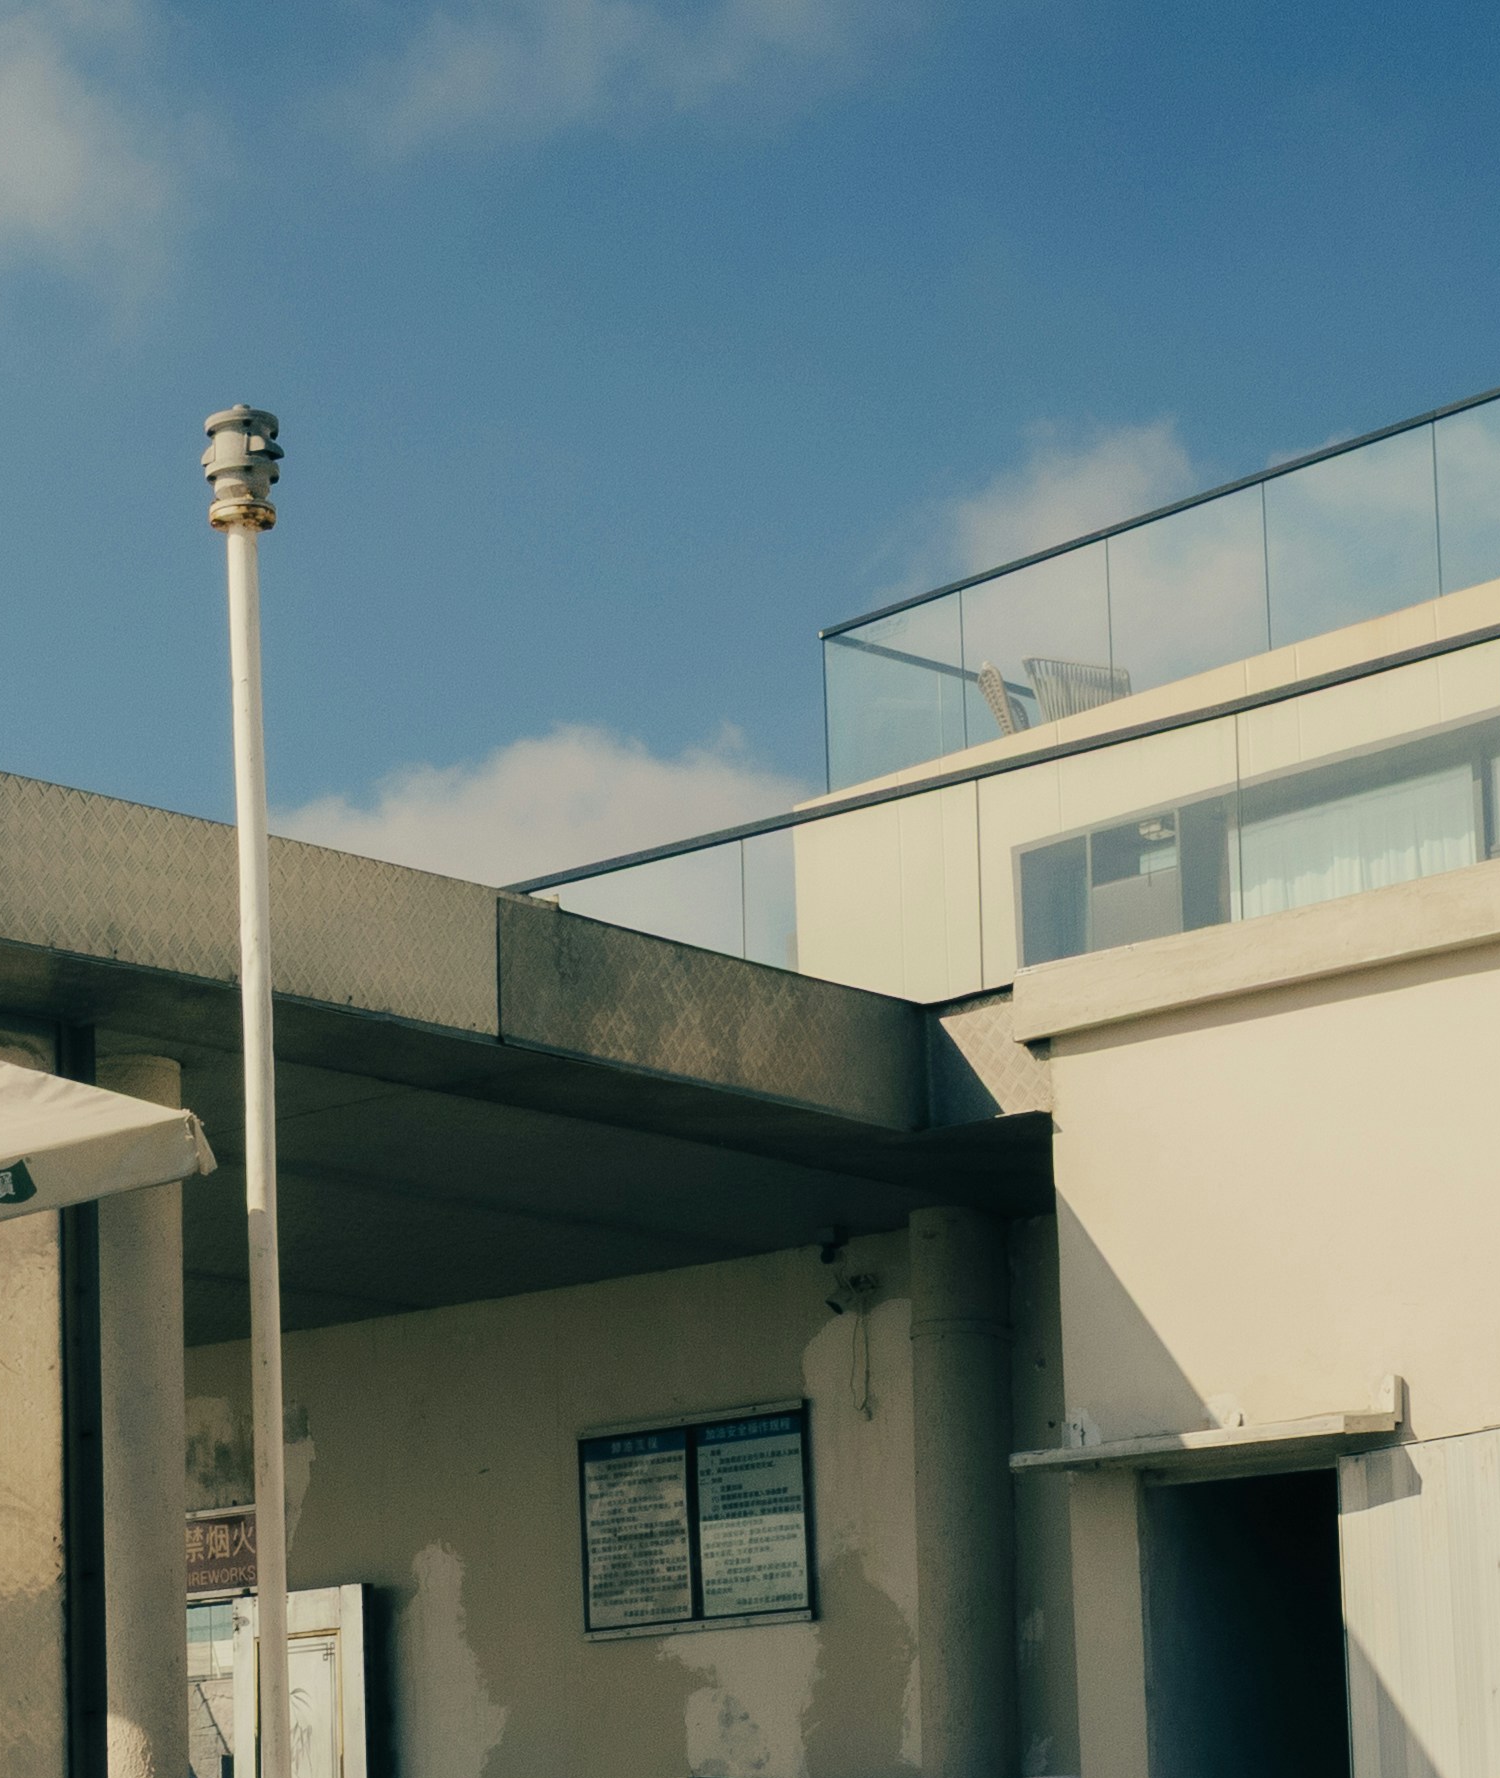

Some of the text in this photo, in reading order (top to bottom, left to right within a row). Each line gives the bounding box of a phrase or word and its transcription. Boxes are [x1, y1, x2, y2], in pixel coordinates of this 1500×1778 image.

[185, 1520, 256, 1563] 禁烟火
[188, 1564, 256, 1586] IREWORKS
